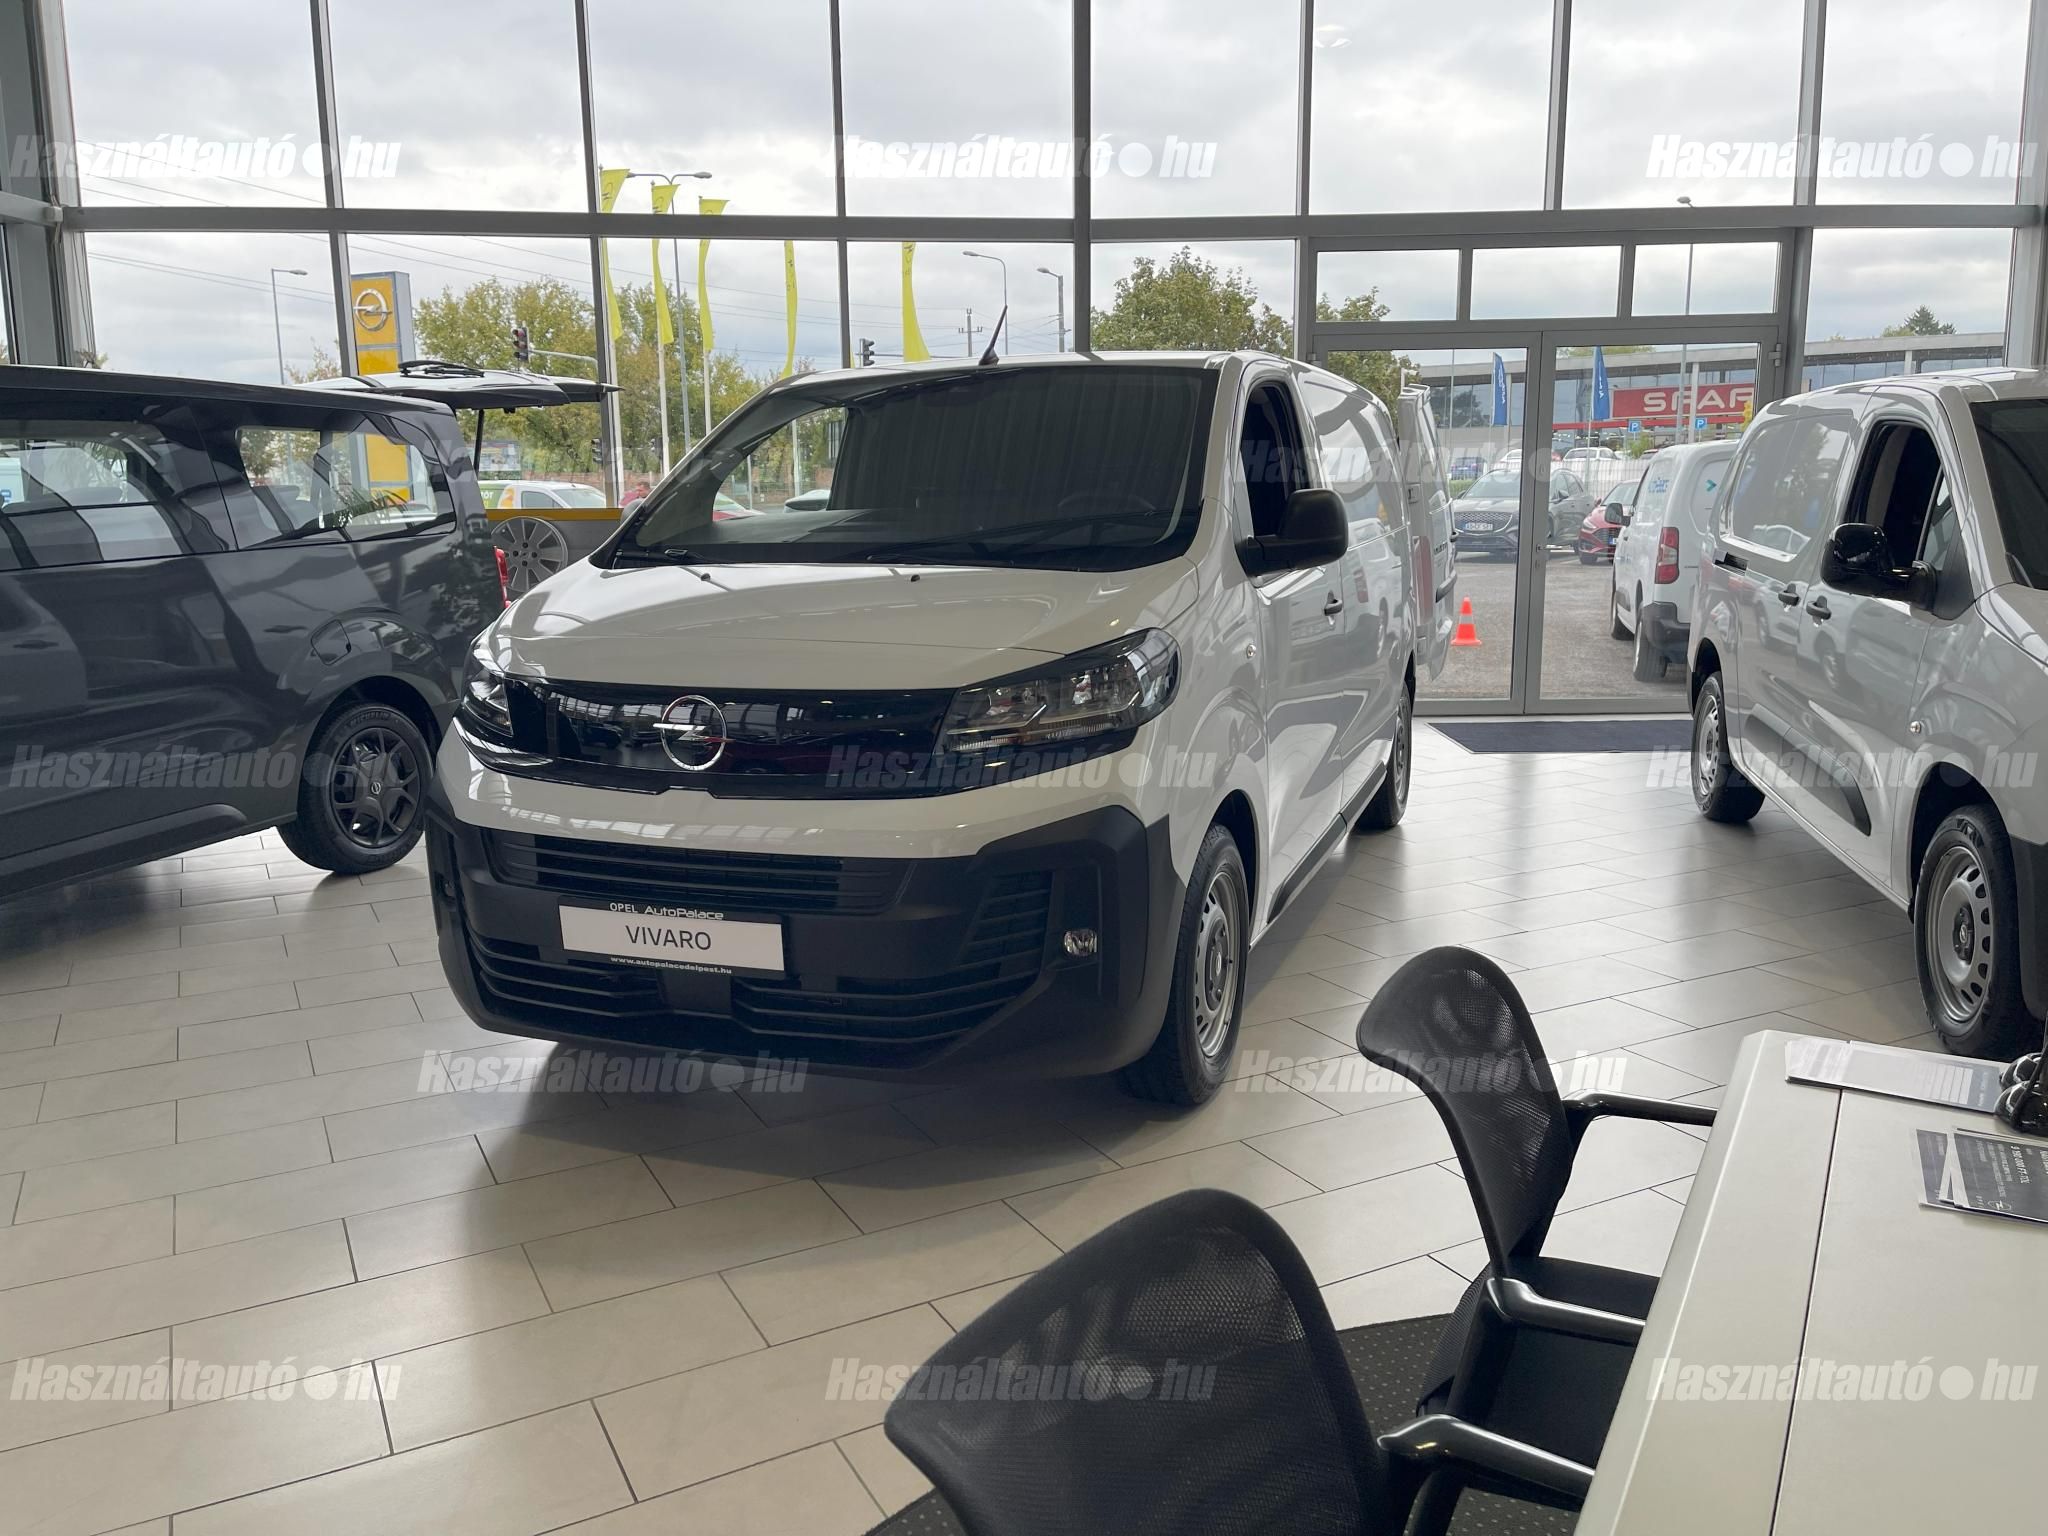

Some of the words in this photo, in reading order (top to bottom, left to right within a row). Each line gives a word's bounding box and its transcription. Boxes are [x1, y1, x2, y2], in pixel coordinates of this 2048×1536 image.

[609, 902, 638, 913] OPEL
[645, 905, 724, 920] AutoPalace
[625, 925, 712, 950] VIVARO
